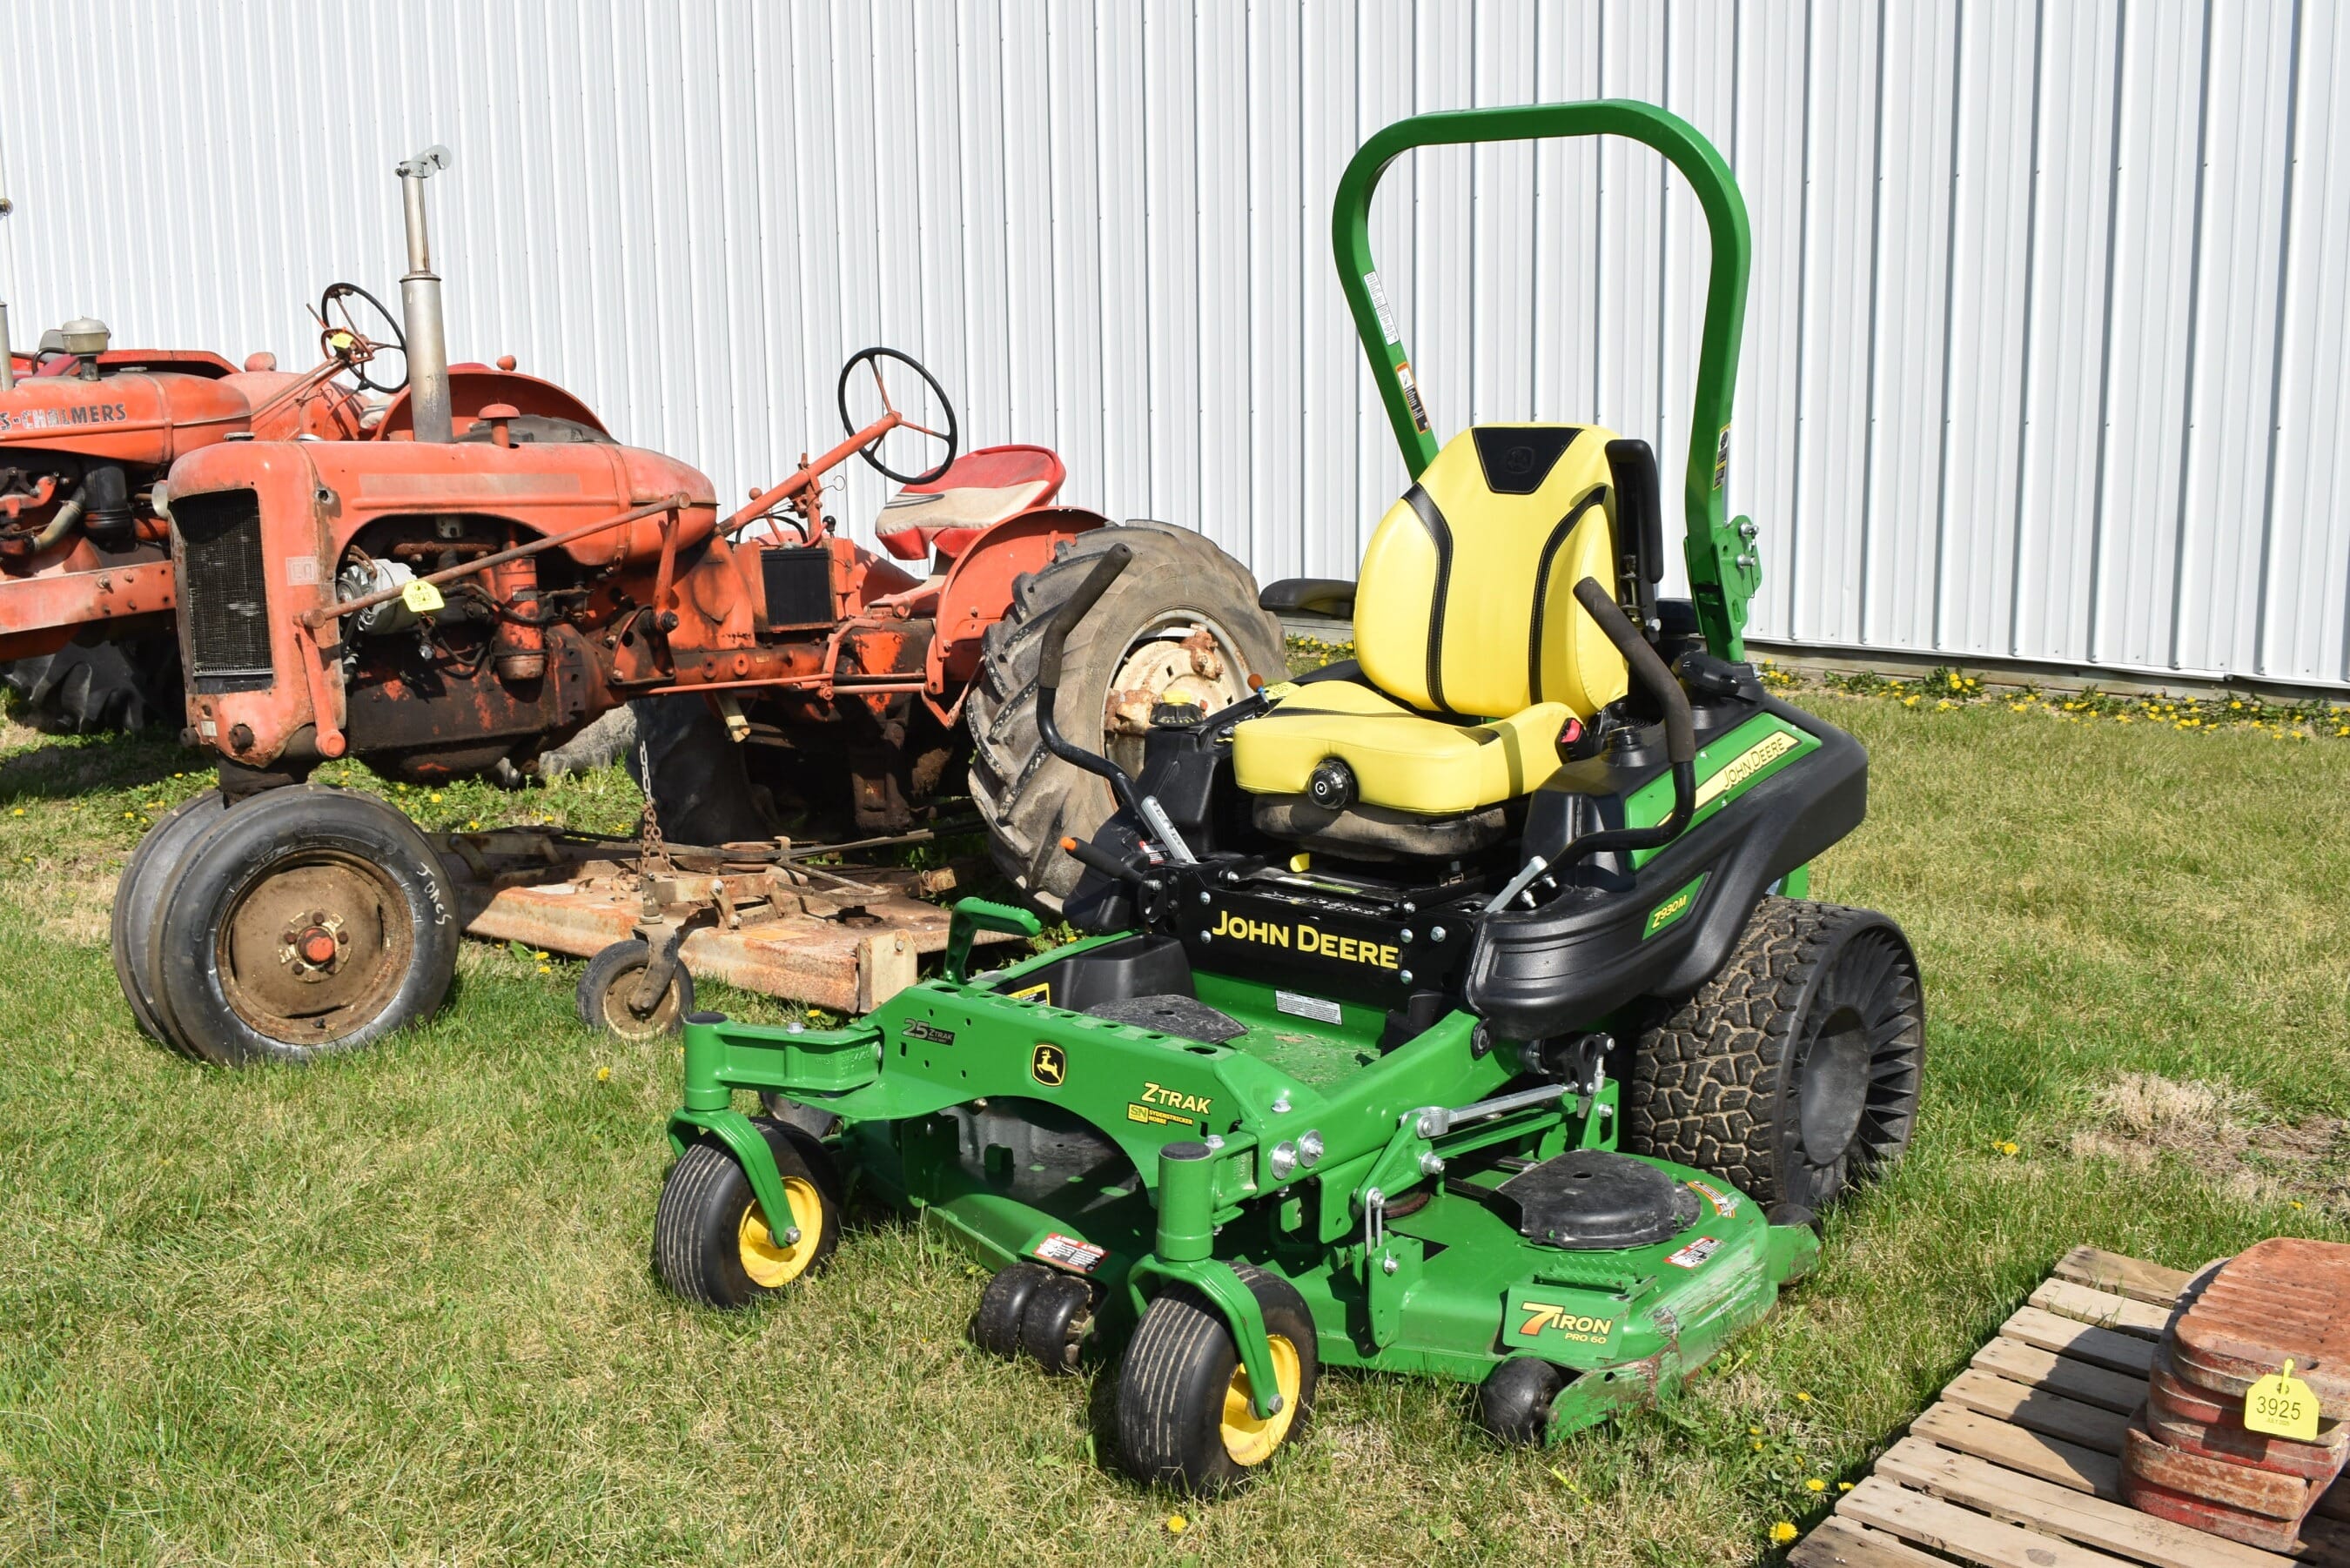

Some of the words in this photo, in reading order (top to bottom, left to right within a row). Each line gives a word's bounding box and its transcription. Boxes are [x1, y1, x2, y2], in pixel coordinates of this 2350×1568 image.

[1723, 758, 1753, 788] JOHN
[1749, 737, 1785, 768] DEERE
[1652, 895, 1688, 928] Z930M
[1212, 910, 1290, 948] JOHN
[1297, 924, 1400, 969] DEERE
[903, 1017, 930, 1039] 25
[928, 1029, 954, 1041] ZTRAK
[1131, 1106, 1147, 1119] SN
[1141, 1082, 1212, 1115] ZTRAK
[1564, 1332, 1588, 1342] PRO
[1590, 1336, 1607, 1344] 60
[2256, 1396, 2301, 1420] 3925
